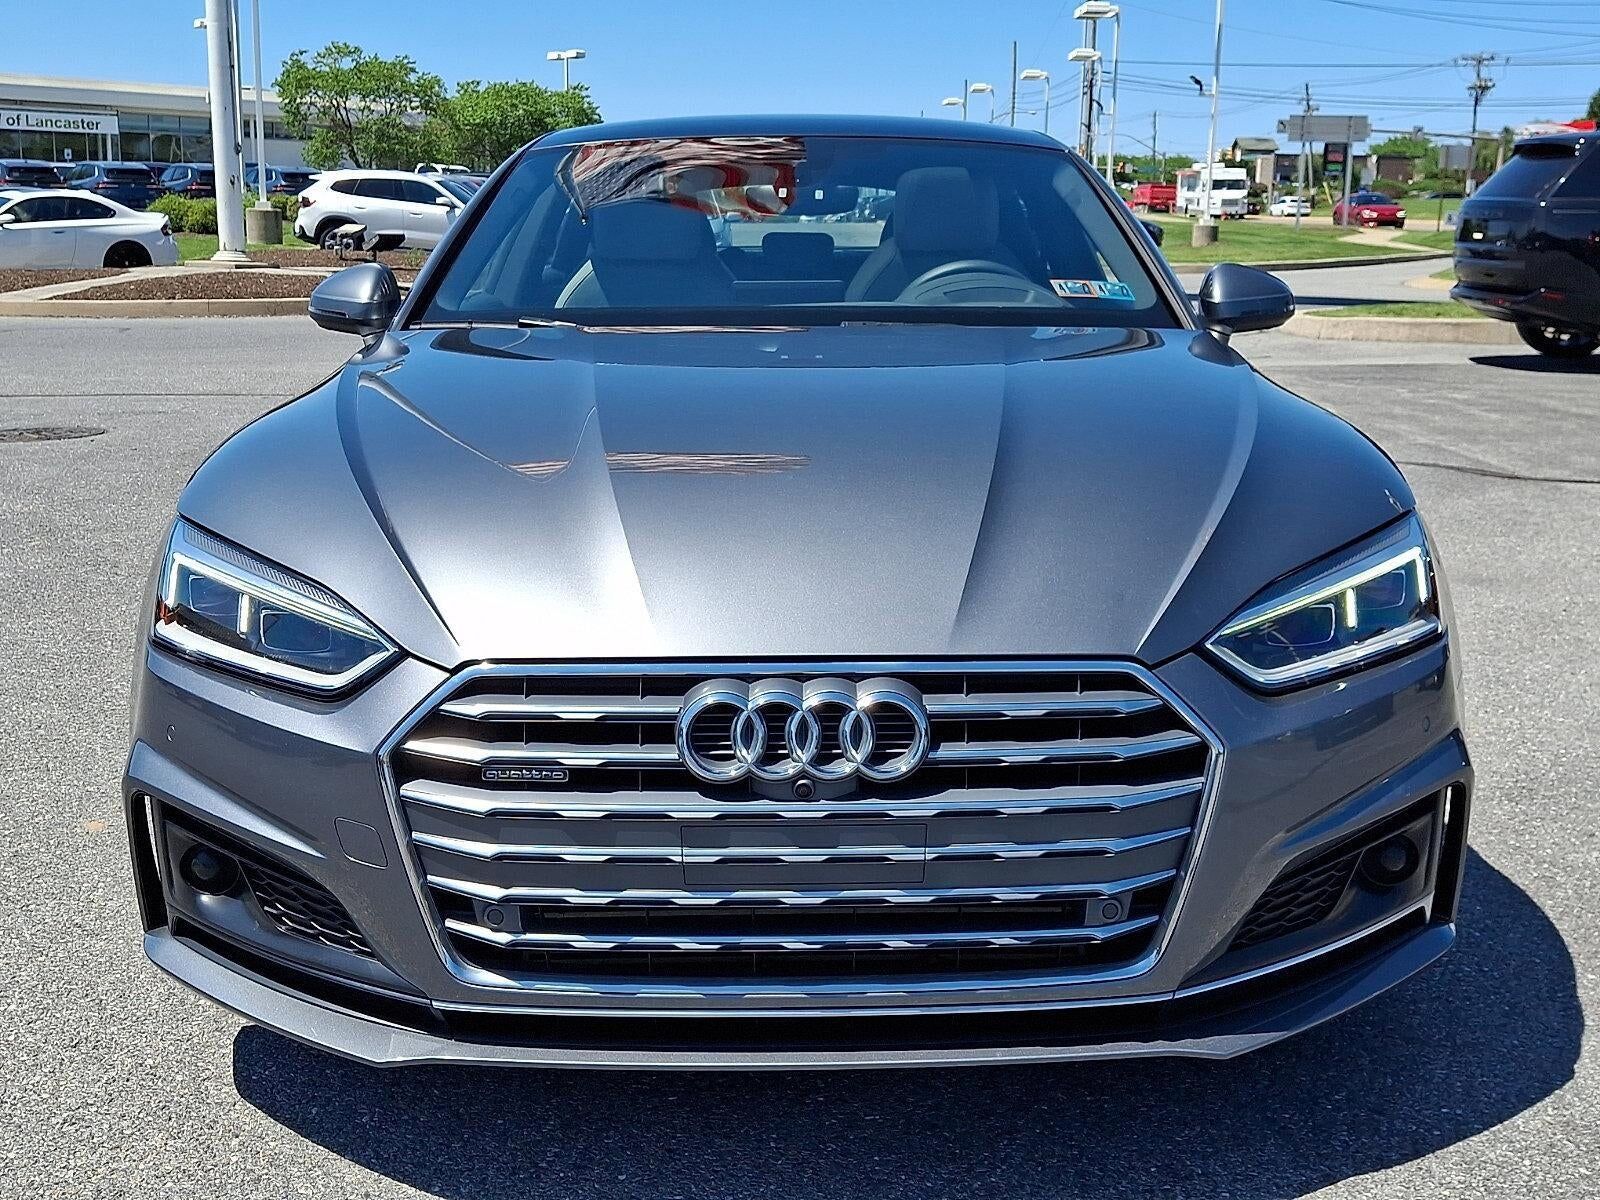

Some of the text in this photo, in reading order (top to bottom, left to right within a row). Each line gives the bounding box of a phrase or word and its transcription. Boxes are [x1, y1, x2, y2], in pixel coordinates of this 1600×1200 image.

[6, 113, 22, 127] of
[26, 114, 101, 131] Lancaster
[486, 769, 565, 780] quattro
